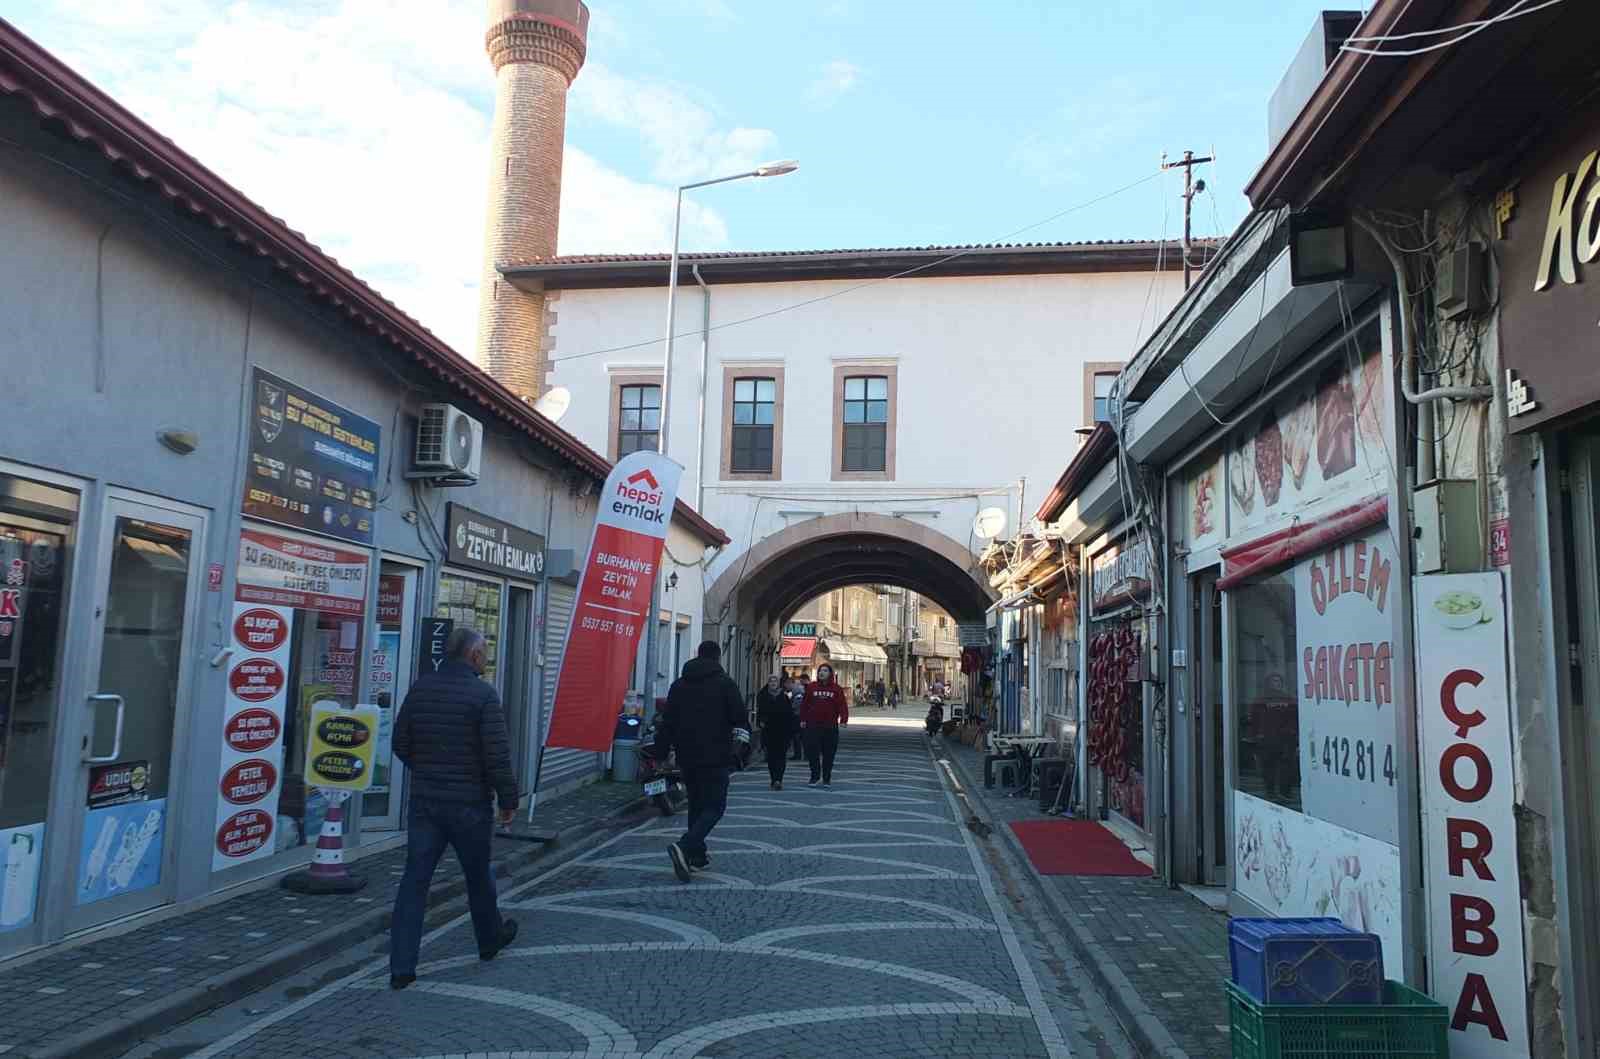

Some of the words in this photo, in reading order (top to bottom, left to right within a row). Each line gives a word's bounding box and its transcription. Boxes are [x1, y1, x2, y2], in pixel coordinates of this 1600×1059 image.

[616, 481, 663, 507] hepsi
[612, 501, 665, 523] emlak
[506, 543, 536, 574] EMLAK
[597, 552, 652, 574] BURHANİYE
[602, 570, 637, 587] ZEYTİN
[1310, 540, 1391, 616] ÖZLEM
[601, 585, 632, 600] EMLAK
[1322, 735, 1350, 777] 412
[1439, 668, 1509, 1043] ÇORBA
